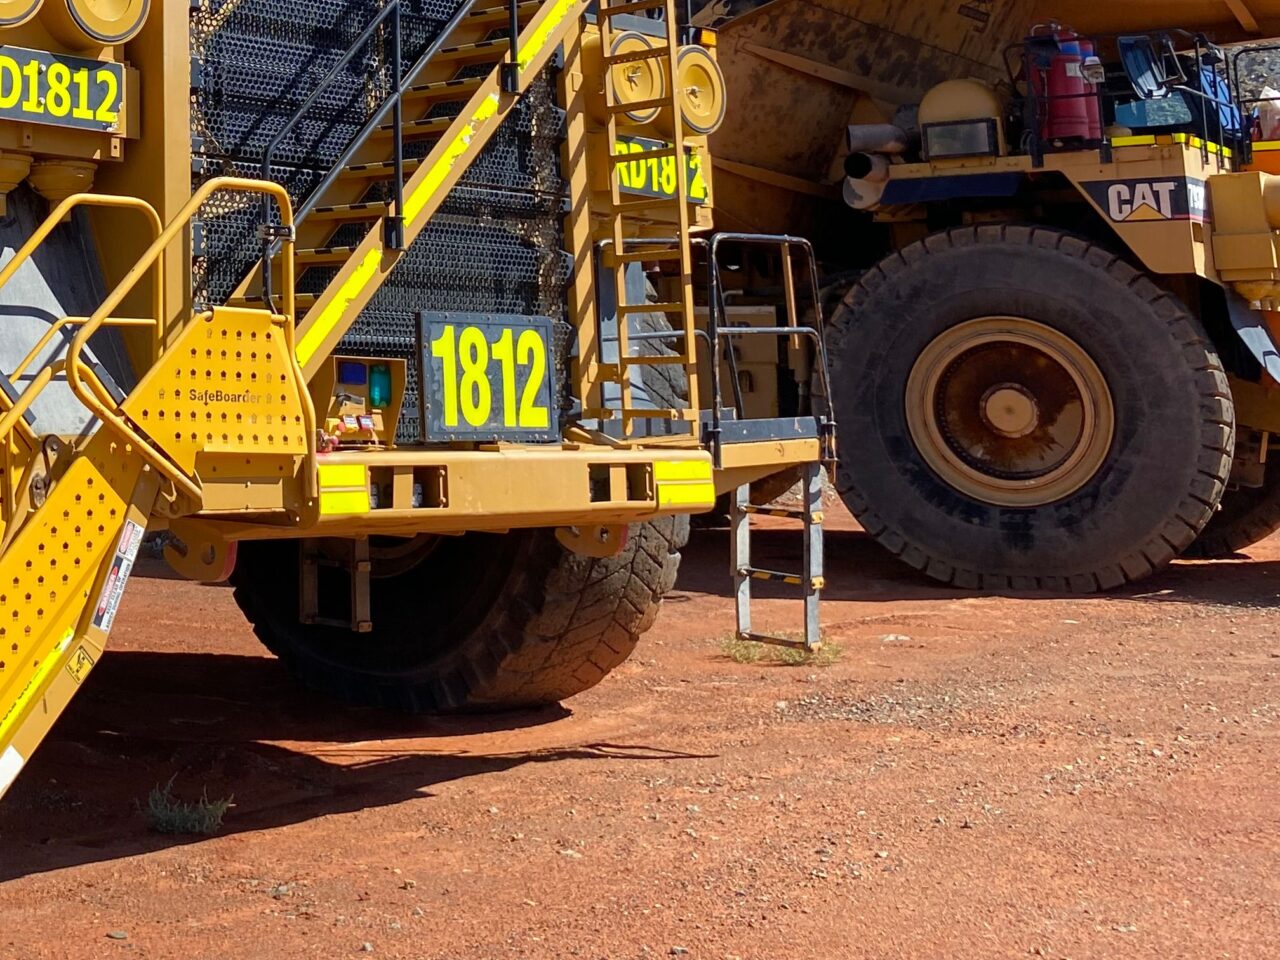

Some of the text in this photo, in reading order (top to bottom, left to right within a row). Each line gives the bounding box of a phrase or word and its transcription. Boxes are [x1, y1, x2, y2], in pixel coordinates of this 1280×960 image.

[615, 142, 704, 199] RD182
[1108, 182, 1175, 220] CAT
[431, 325, 549, 428] 1812
[189, 388, 261, 406] SafeBoarder
[100, 574, 116, 608] DANGER
